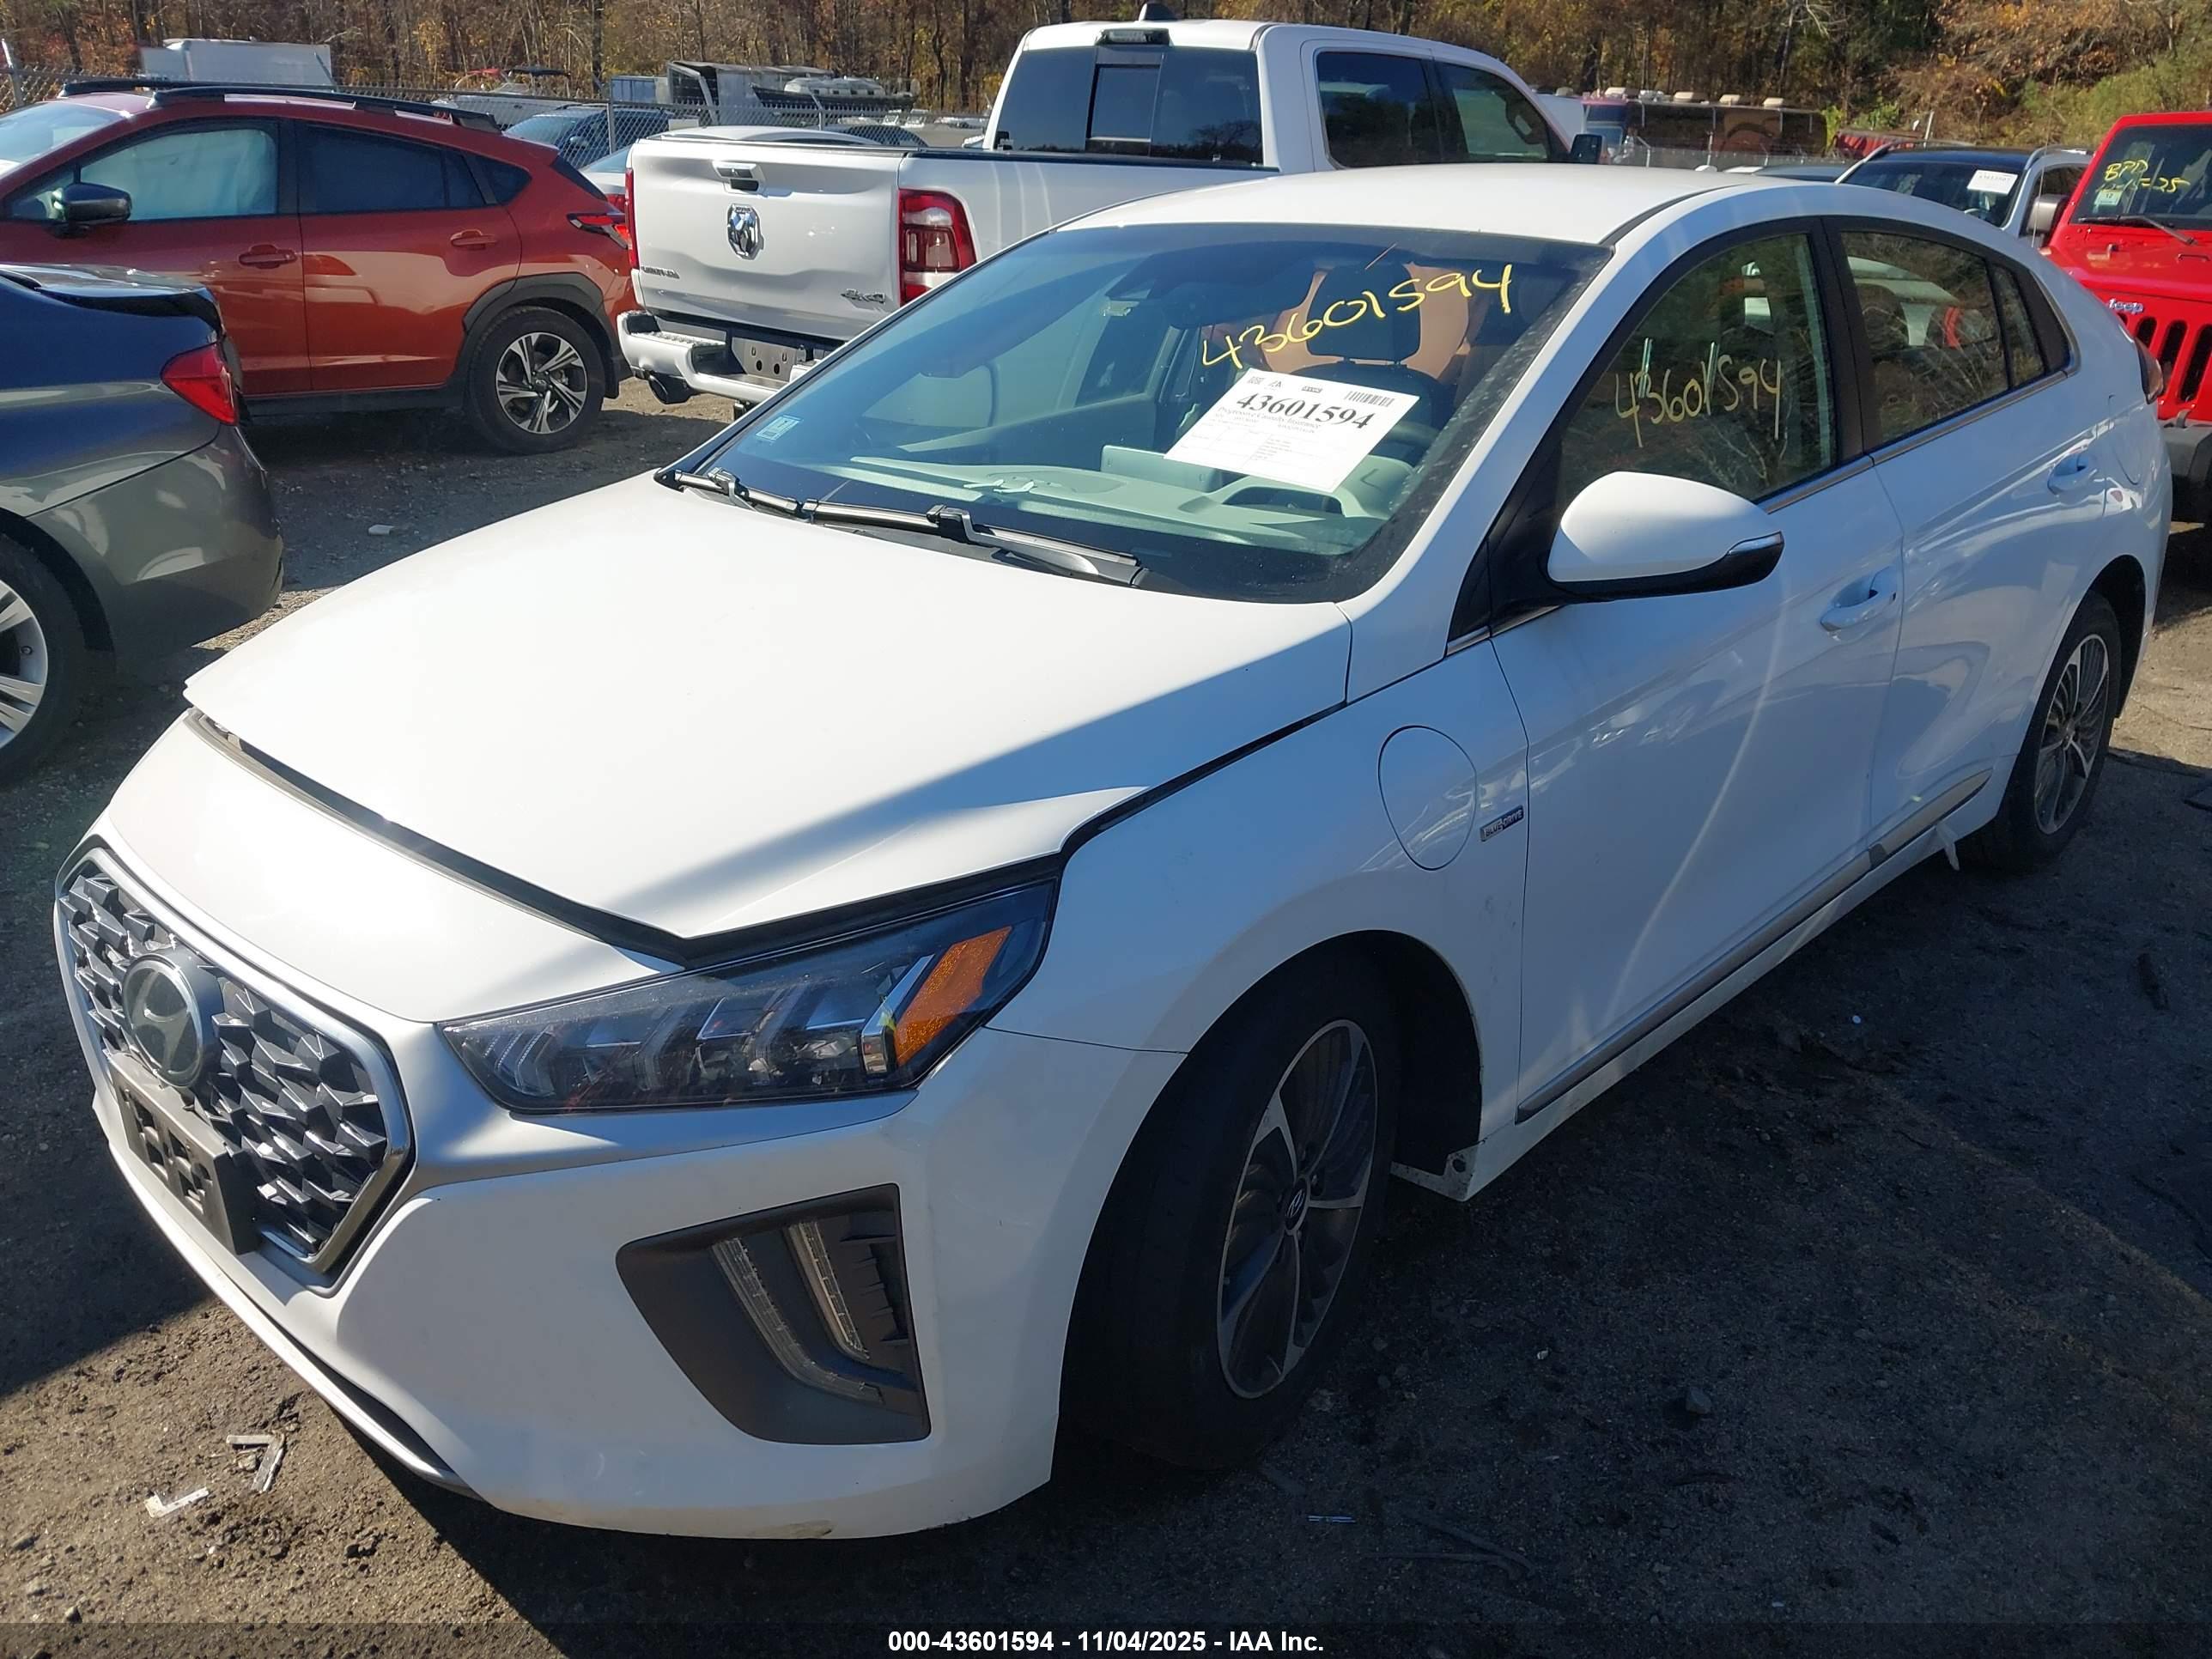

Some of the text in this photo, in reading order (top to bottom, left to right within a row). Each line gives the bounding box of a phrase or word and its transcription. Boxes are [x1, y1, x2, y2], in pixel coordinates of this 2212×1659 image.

[1202, 264, 1512, 369] 43601594
[1237, 392, 1376, 429] 43601594
[1615, 355, 1782, 448] 43601594
